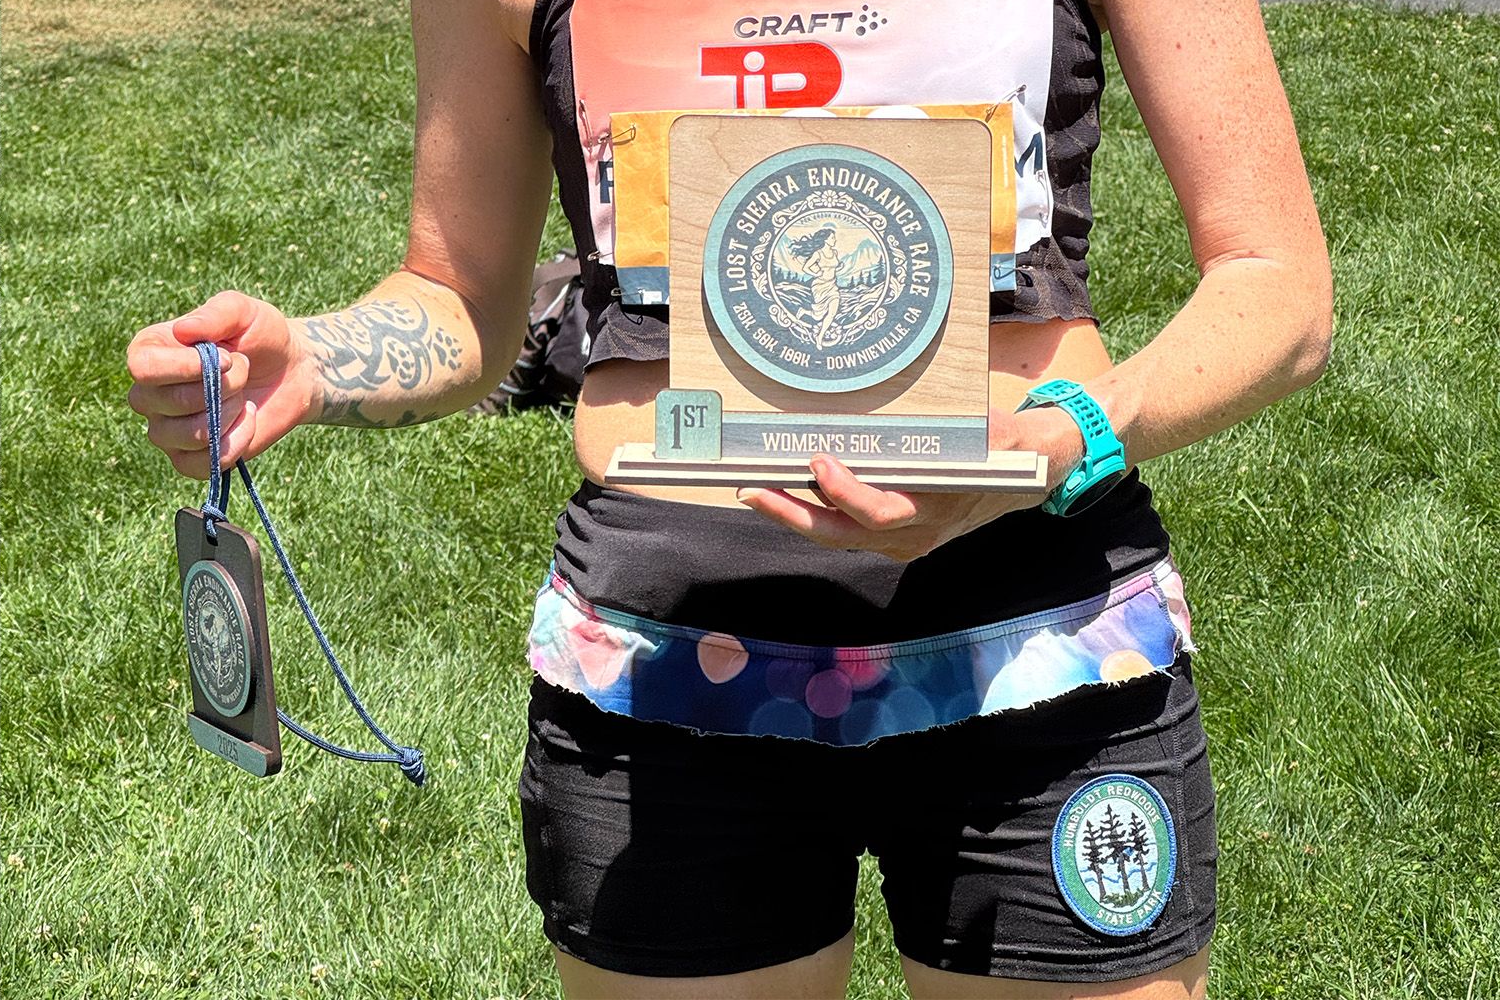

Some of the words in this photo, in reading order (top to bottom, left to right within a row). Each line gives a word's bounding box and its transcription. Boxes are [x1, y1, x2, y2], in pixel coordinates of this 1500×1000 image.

[733, 11, 853, 38] CRAFT
[736, 174, 801, 235] SIERRA
[807, 166, 923, 237] ENDURANCE
[726, 238, 748, 292] LOST
[908, 242, 931, 298] RACE
[779, 345, 812, 368] 100K
[903, 306, 923, 324] CA
[669, 404, 708, 450] 1ST
[761, 431, 845, 454] WOMEN'S
[850, 433, 882, 455] 50K
[901, 434, 941, 455] 2025
[1063, 789, 1102, 848] HUMBOLDT
[1106, 785, 1161, 824] REDWOODS
[1096, 909, 1133, 926] STATE
[1136, 888, 1164, 920] PARK
